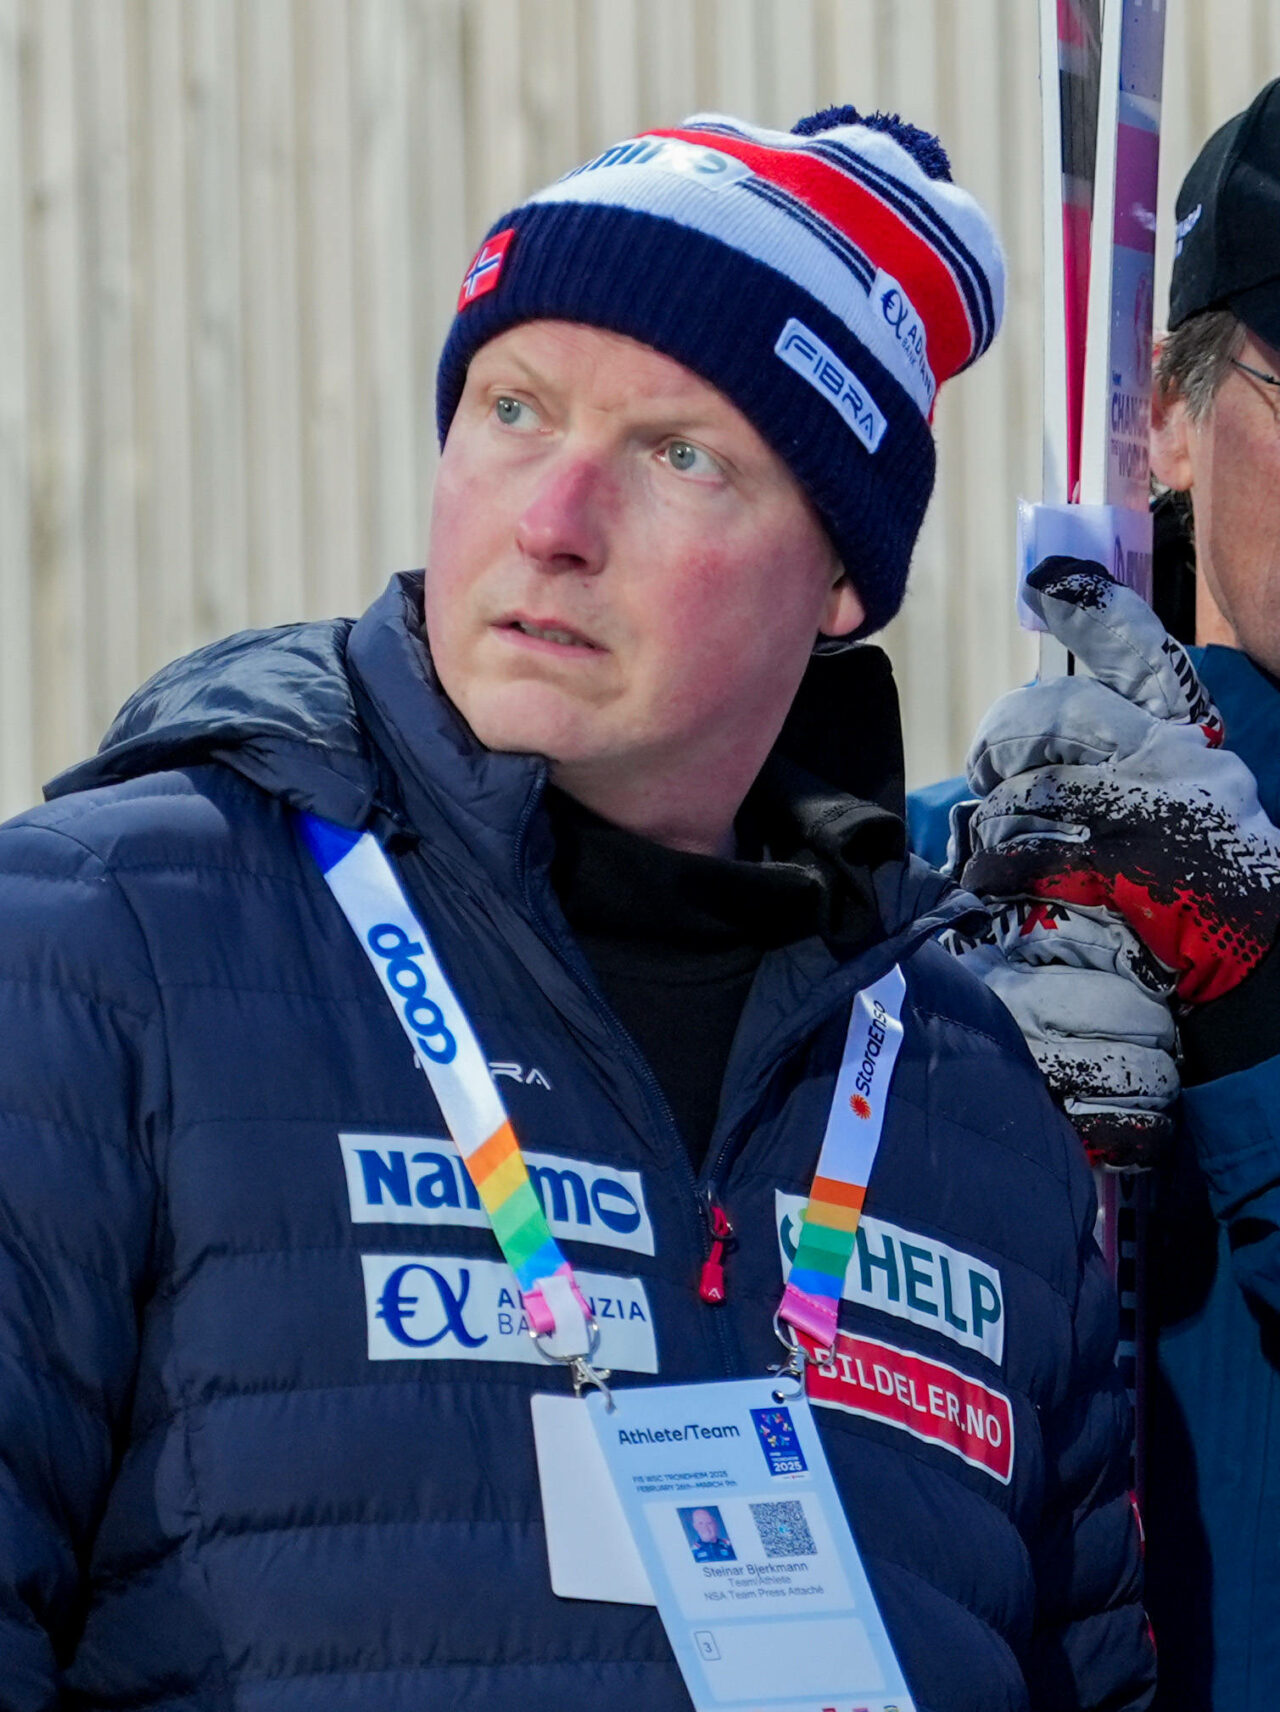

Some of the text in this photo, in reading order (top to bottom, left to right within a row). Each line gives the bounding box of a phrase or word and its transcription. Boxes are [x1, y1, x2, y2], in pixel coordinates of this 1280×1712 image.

[785, 334, 874, 441] FIBRA
[367, 923, 457, 1065] coop
[856, 1226, 1001, 1339] HELP
[618, 1424, 740, 1446] Athlete/Team
[814, 1348, 1002, 1448] BILDELER.NO
[702, 1561, 809, 1578] Steinar Bjerkmann
[728, 1589, 757, 1600] Team
[757, 1587, 786, 1598] Press
